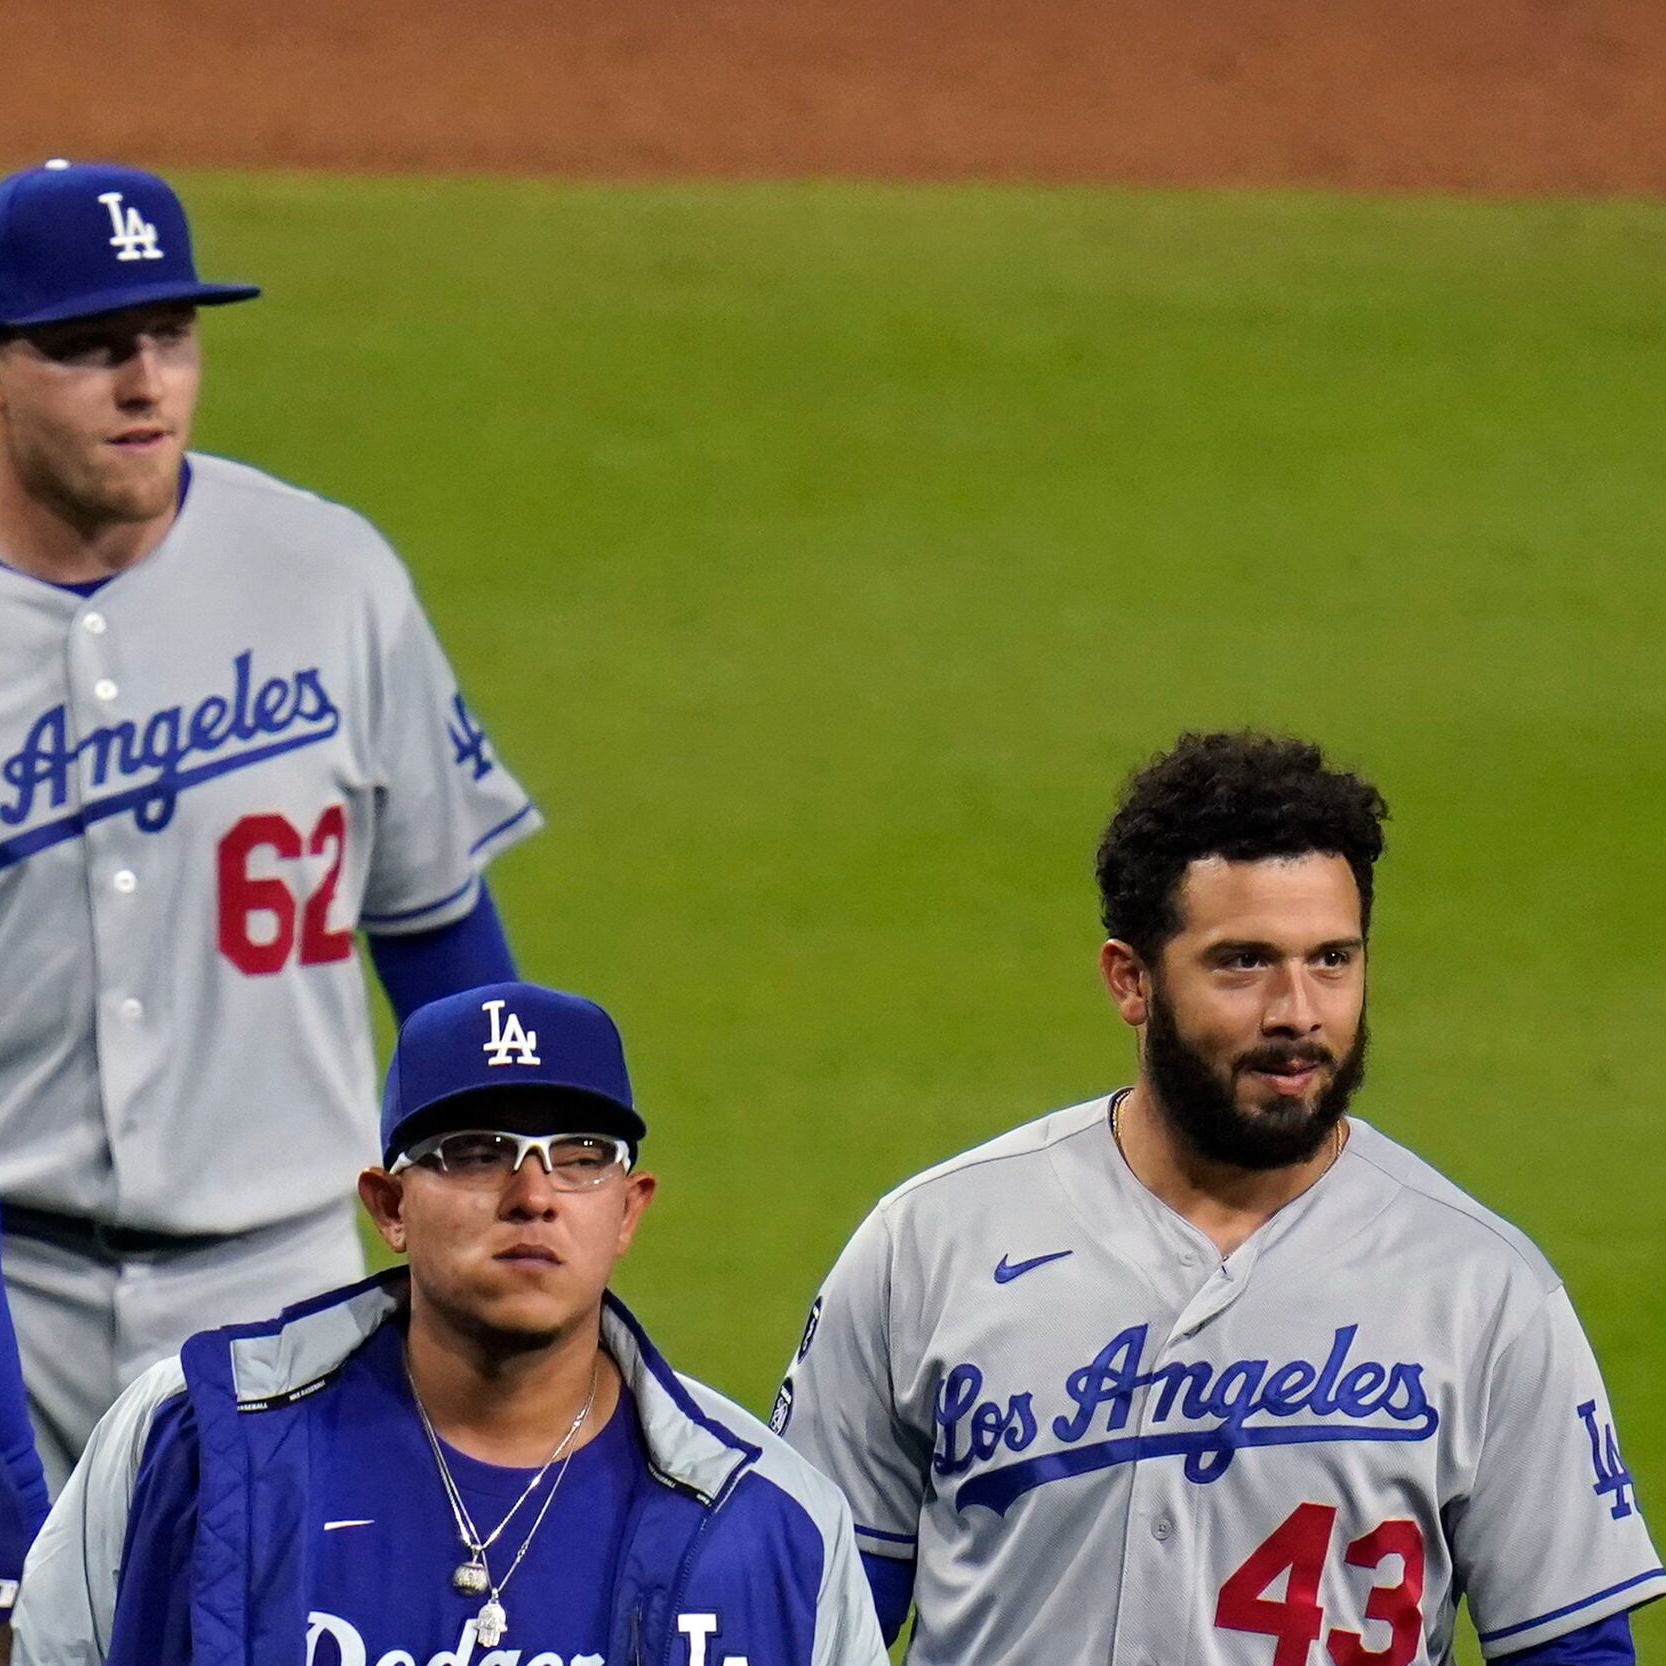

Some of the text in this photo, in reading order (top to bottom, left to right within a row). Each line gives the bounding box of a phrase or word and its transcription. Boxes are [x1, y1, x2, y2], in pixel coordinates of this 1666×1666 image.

[98, 192, 164, 261] LA
[216, 805, 352, 976] 62
[482, 1000, 541, 1066] LA
[934, 1323, 1439, 1484] Los Angeles
